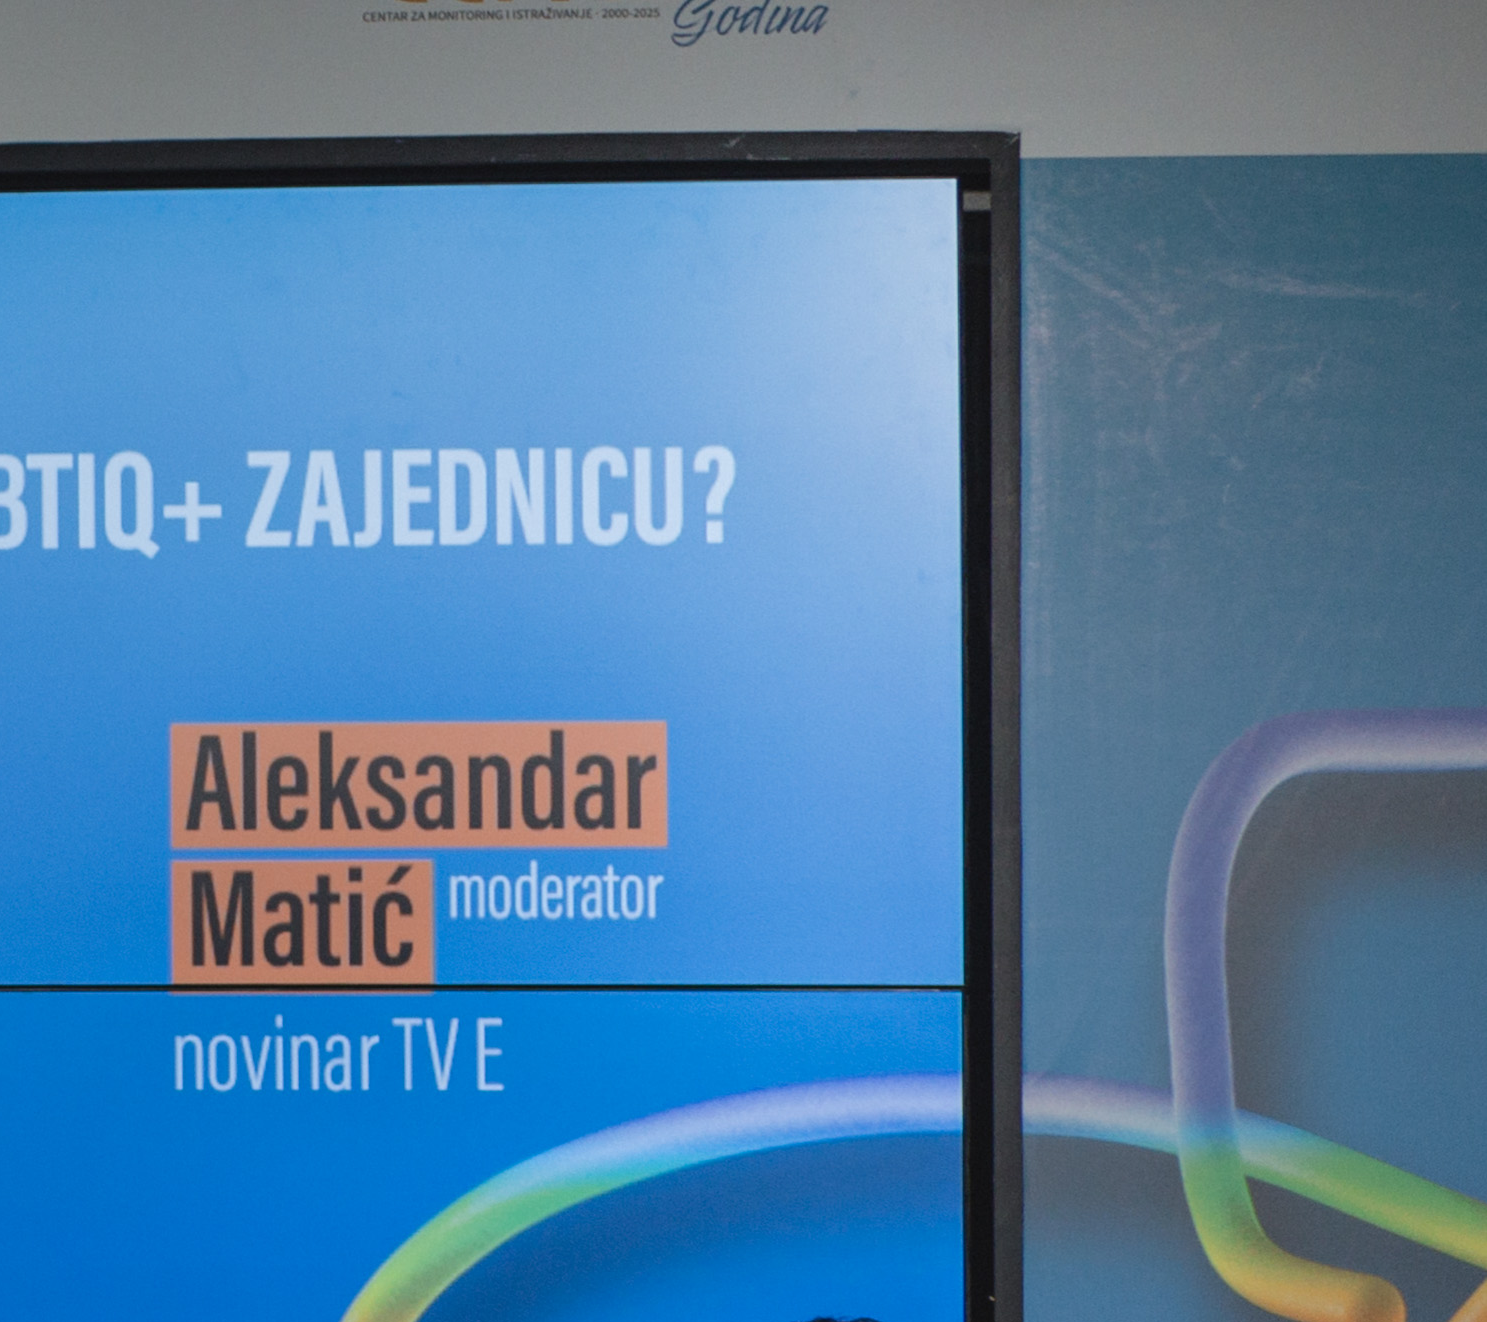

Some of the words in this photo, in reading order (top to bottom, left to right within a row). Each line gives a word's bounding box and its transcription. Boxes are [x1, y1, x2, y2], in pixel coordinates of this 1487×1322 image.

[362, 11, 408, 22] CENTAR
[411, 11, 425, 22] ZA
[428, 9, 503, 21] MONITORING
[513, 7, 592, 20] ISTRAŽIVANJE
[602, 8, 660, 19] 2000-2025
[245, 444, 737, 548] ZAJEDNICU?
[185, 729, 657, 831] Aleksandar
[191, 866, 414, 968] Matić
[449, 860, 664, 920] moderator
[174, 1014, 379, 1091] novinar
[392, 1017, 459, 1091] TV
[476, 1017, 505, 1092] E
